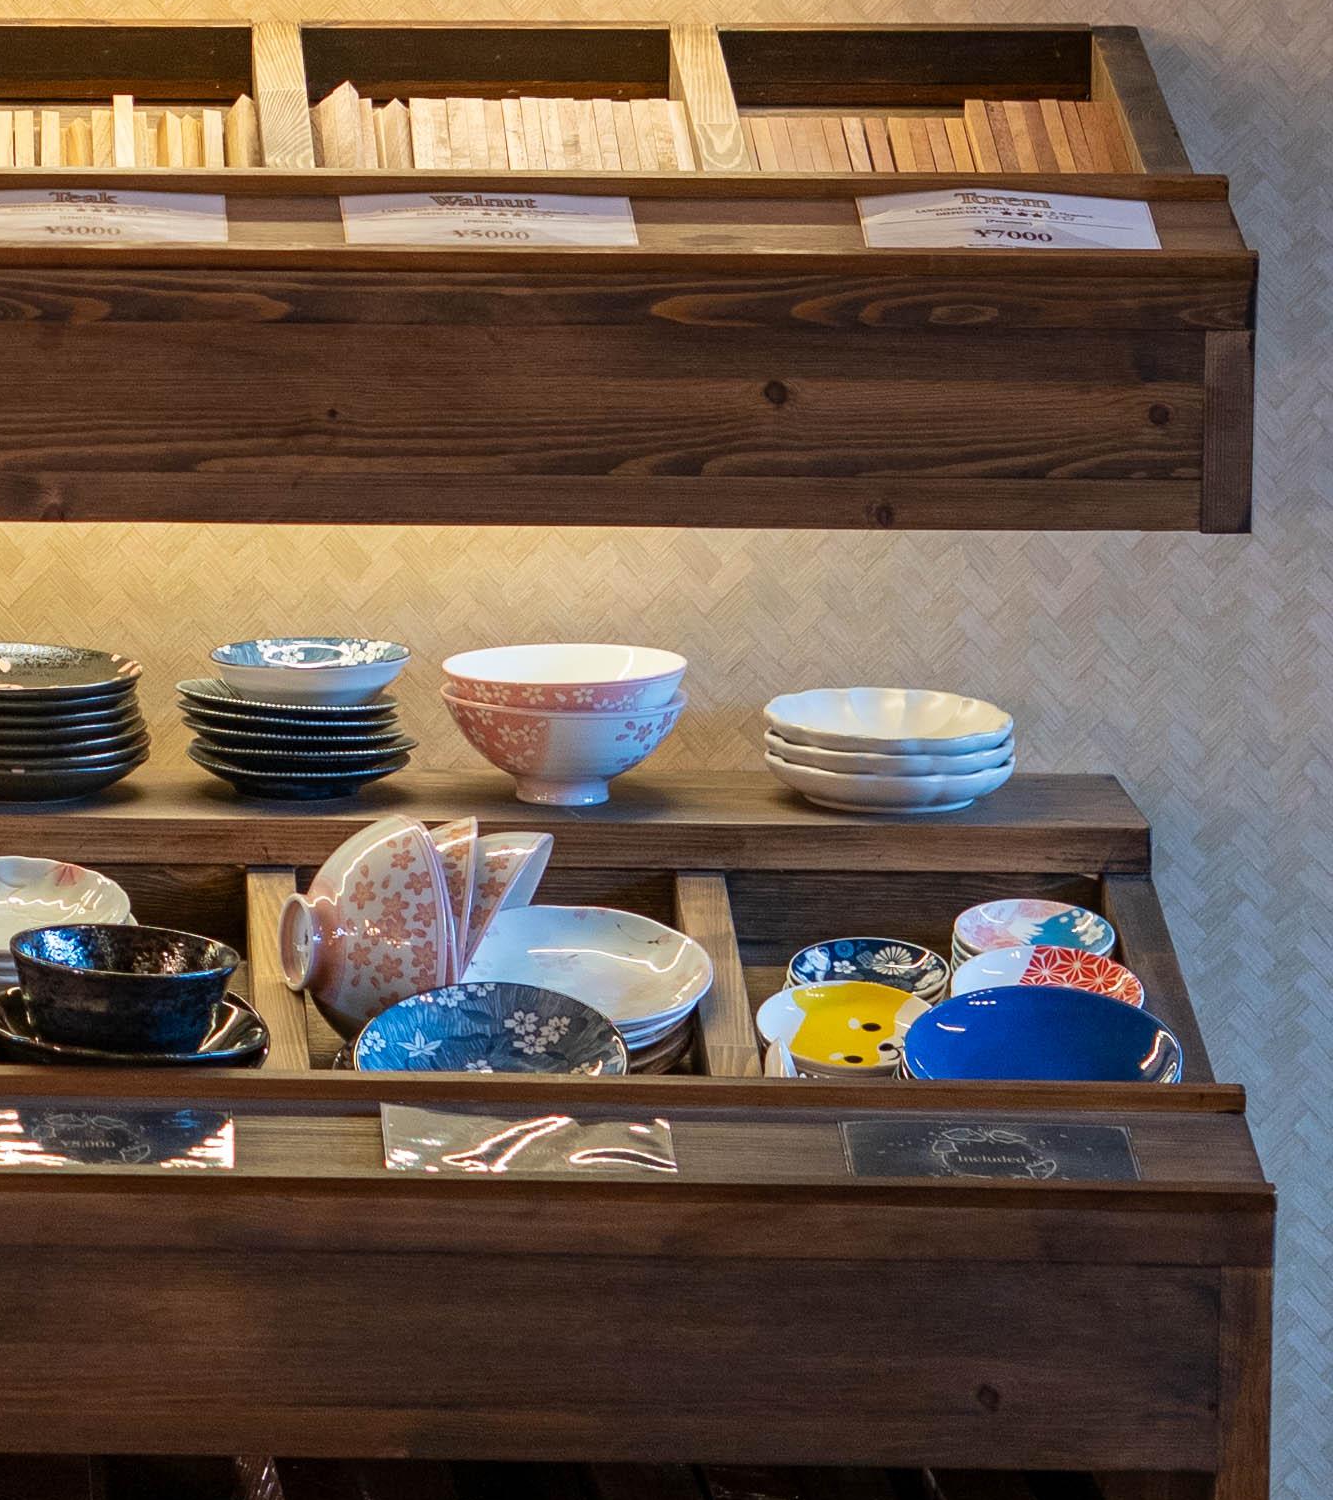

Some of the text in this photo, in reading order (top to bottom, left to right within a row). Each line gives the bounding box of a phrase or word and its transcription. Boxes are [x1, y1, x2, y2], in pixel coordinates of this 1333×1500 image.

[48, 191, 118, 204] Teak
[429, 194, 538, 209] Walnut
[954, 191, 1052, 209] Torem
[44, 224, 121, 237] ¥3000
[452, 228, 530, 241] ¥5000
[973, 228, 1053, 243] ¥7000
